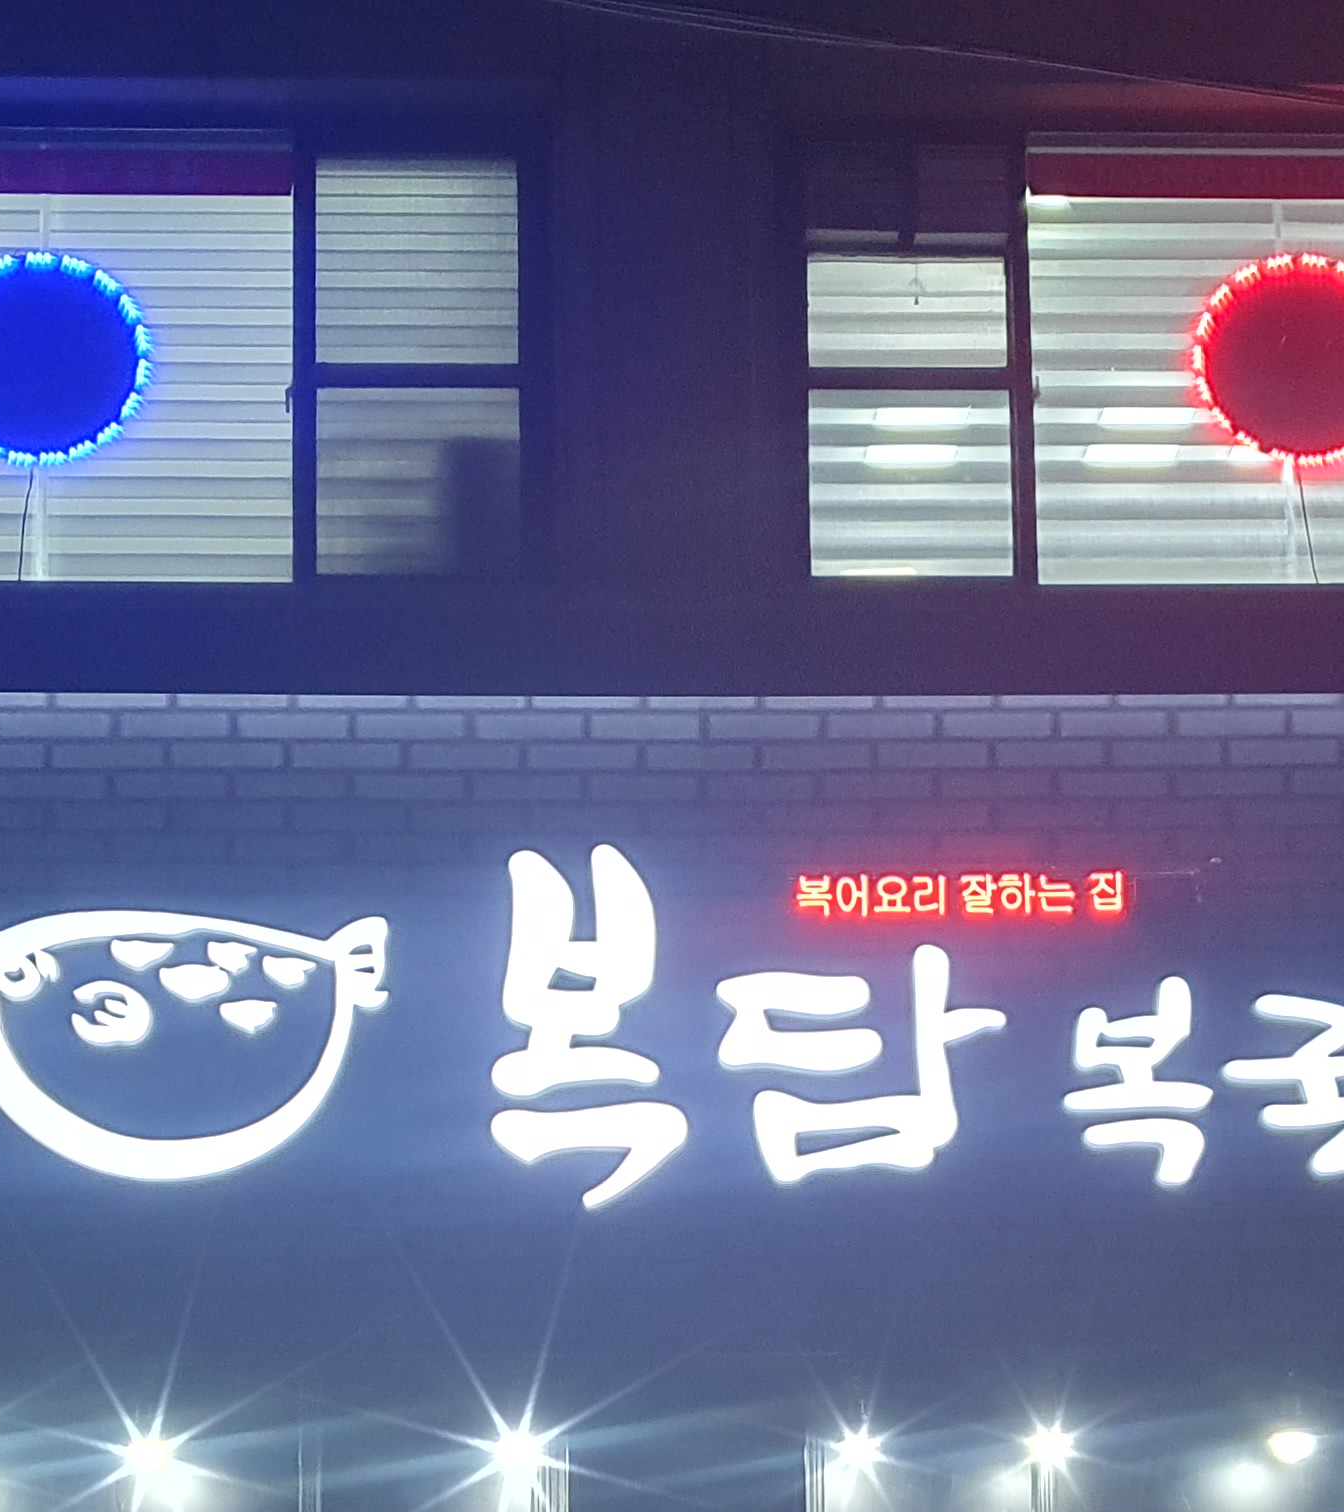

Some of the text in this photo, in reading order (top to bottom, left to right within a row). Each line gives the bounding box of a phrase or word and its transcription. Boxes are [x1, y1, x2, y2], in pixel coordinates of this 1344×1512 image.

[796, 871, 1126, 918] 복어요리 잘하는 집
[490, 843, 1007, 1210] 복담
